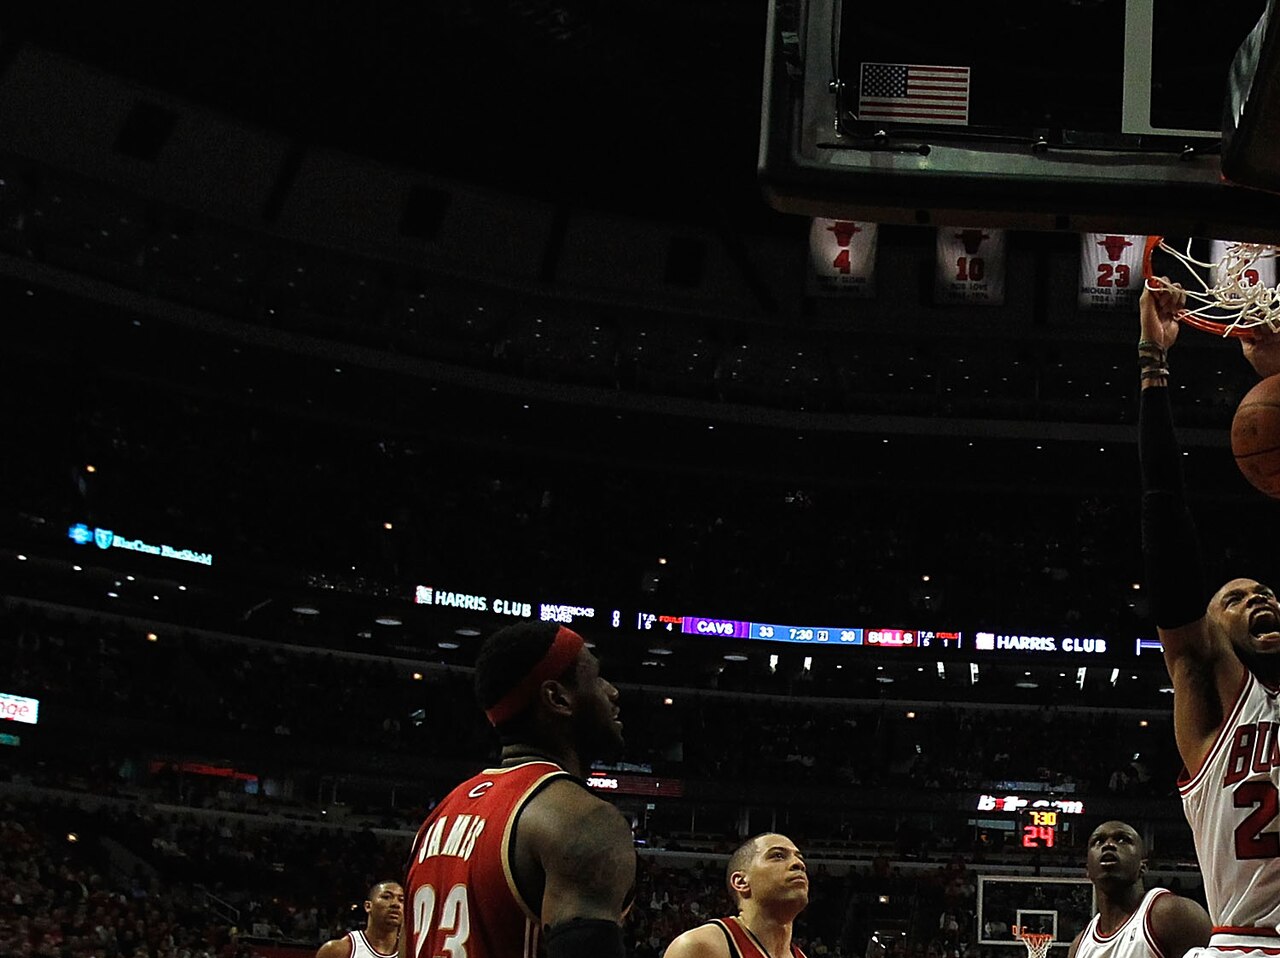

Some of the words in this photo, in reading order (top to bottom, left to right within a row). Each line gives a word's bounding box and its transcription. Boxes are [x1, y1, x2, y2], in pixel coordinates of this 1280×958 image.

[834, 249, 850, 274] 4
[957, 257, 984, 282] 10
[1097, 263, 1130, 288] 23
[492, 599, 532, 618] CLUB
[541, 603, 595, 617] MAVERICKS
[541, 612, 573, 624] SPURS
[666, 622, 673, 631] 4
[697, 619, 734, 636] CAVS
[758, 625, 774, 638] 33
[788, 628, 814, 641] 7:30
[840, 629, 855, 642] 30
[868, 632, 914, 645] BULLS
[944, 639, 949, 648] 1
[1061, 638, 1106, 653] CLUB
[1029, 811, 1057, 826] 7:30
[418, 813, 487, 865] JAMES
[1023, 826, 1054, 847] 24
